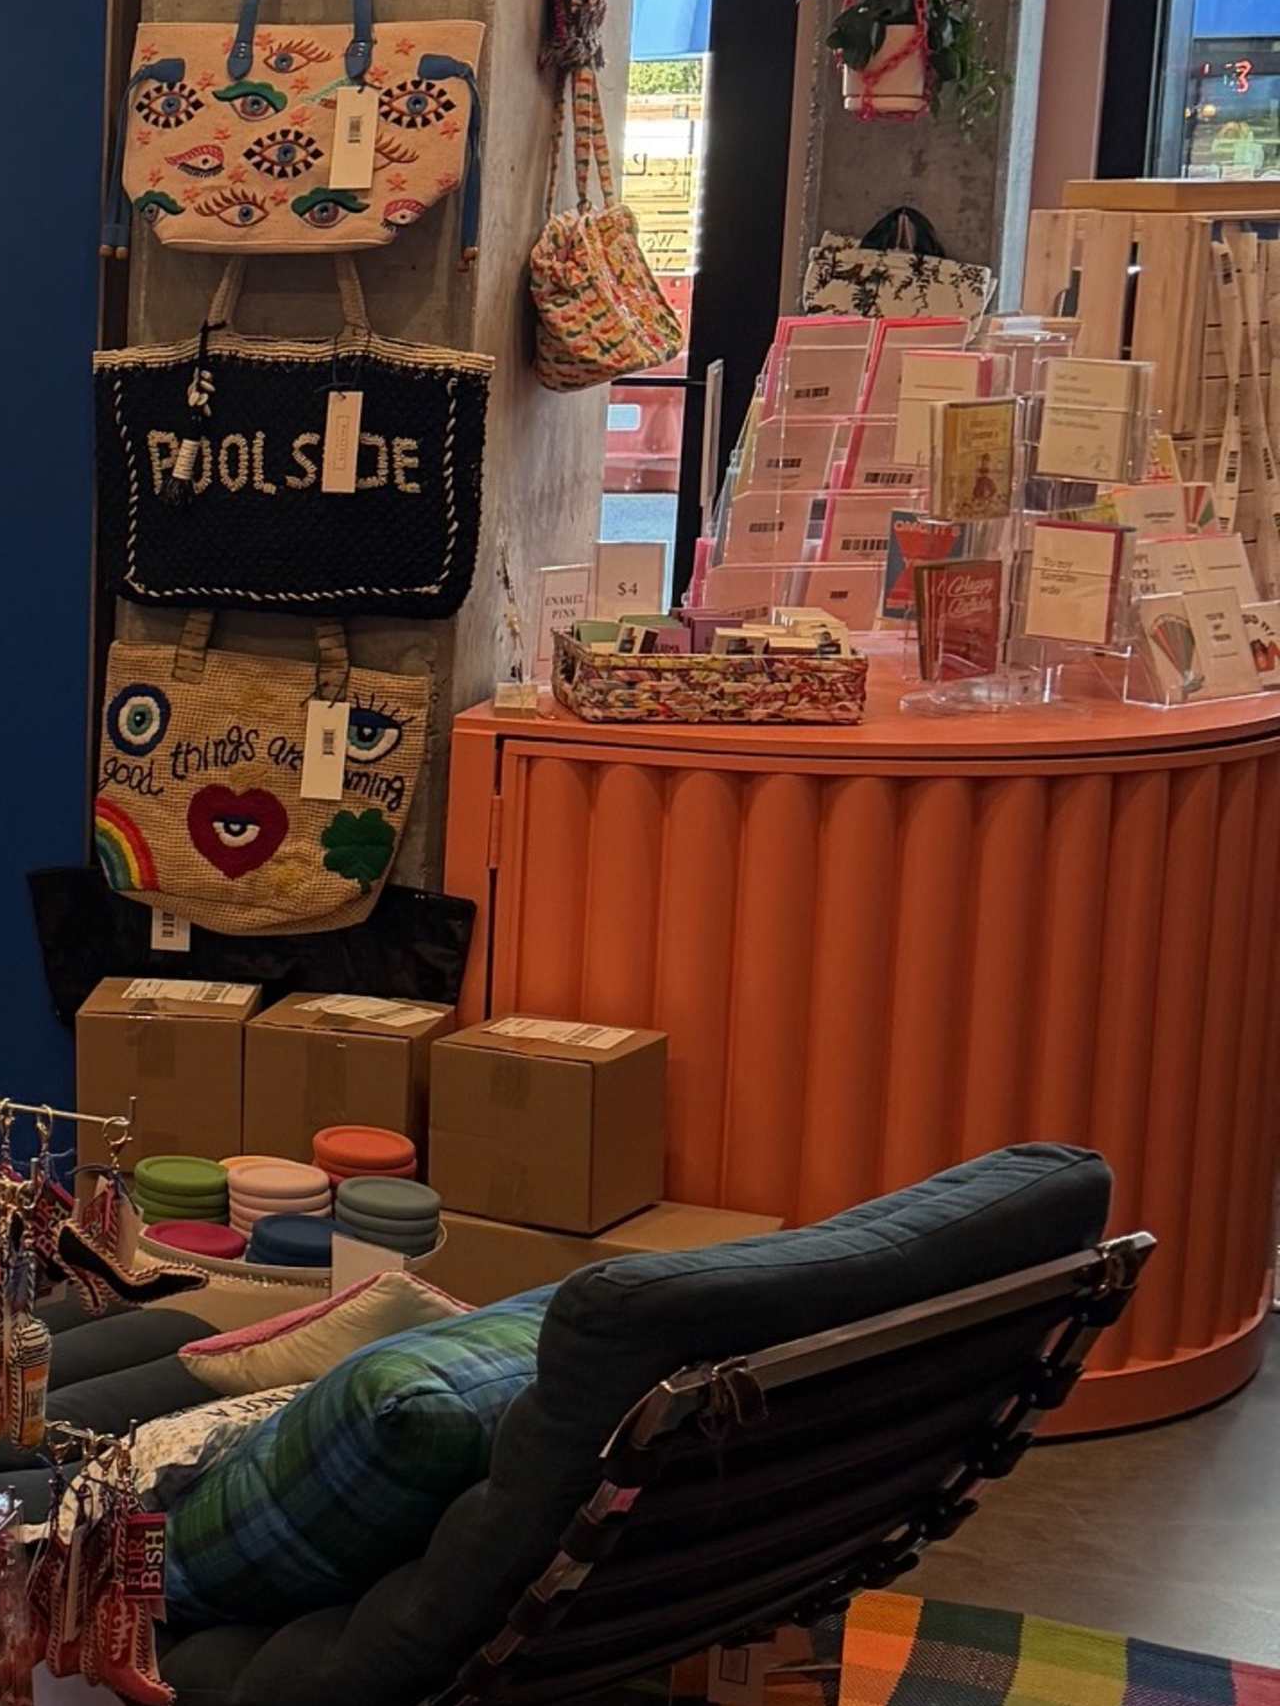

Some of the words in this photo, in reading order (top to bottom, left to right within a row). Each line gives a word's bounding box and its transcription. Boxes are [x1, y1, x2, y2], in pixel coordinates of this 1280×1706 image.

[147, 429, 421, 495] POOLSDE
[96, 757, 164, 796] good
[170, 725, 260, 780] things
[342, 768, 406, 812] ming
